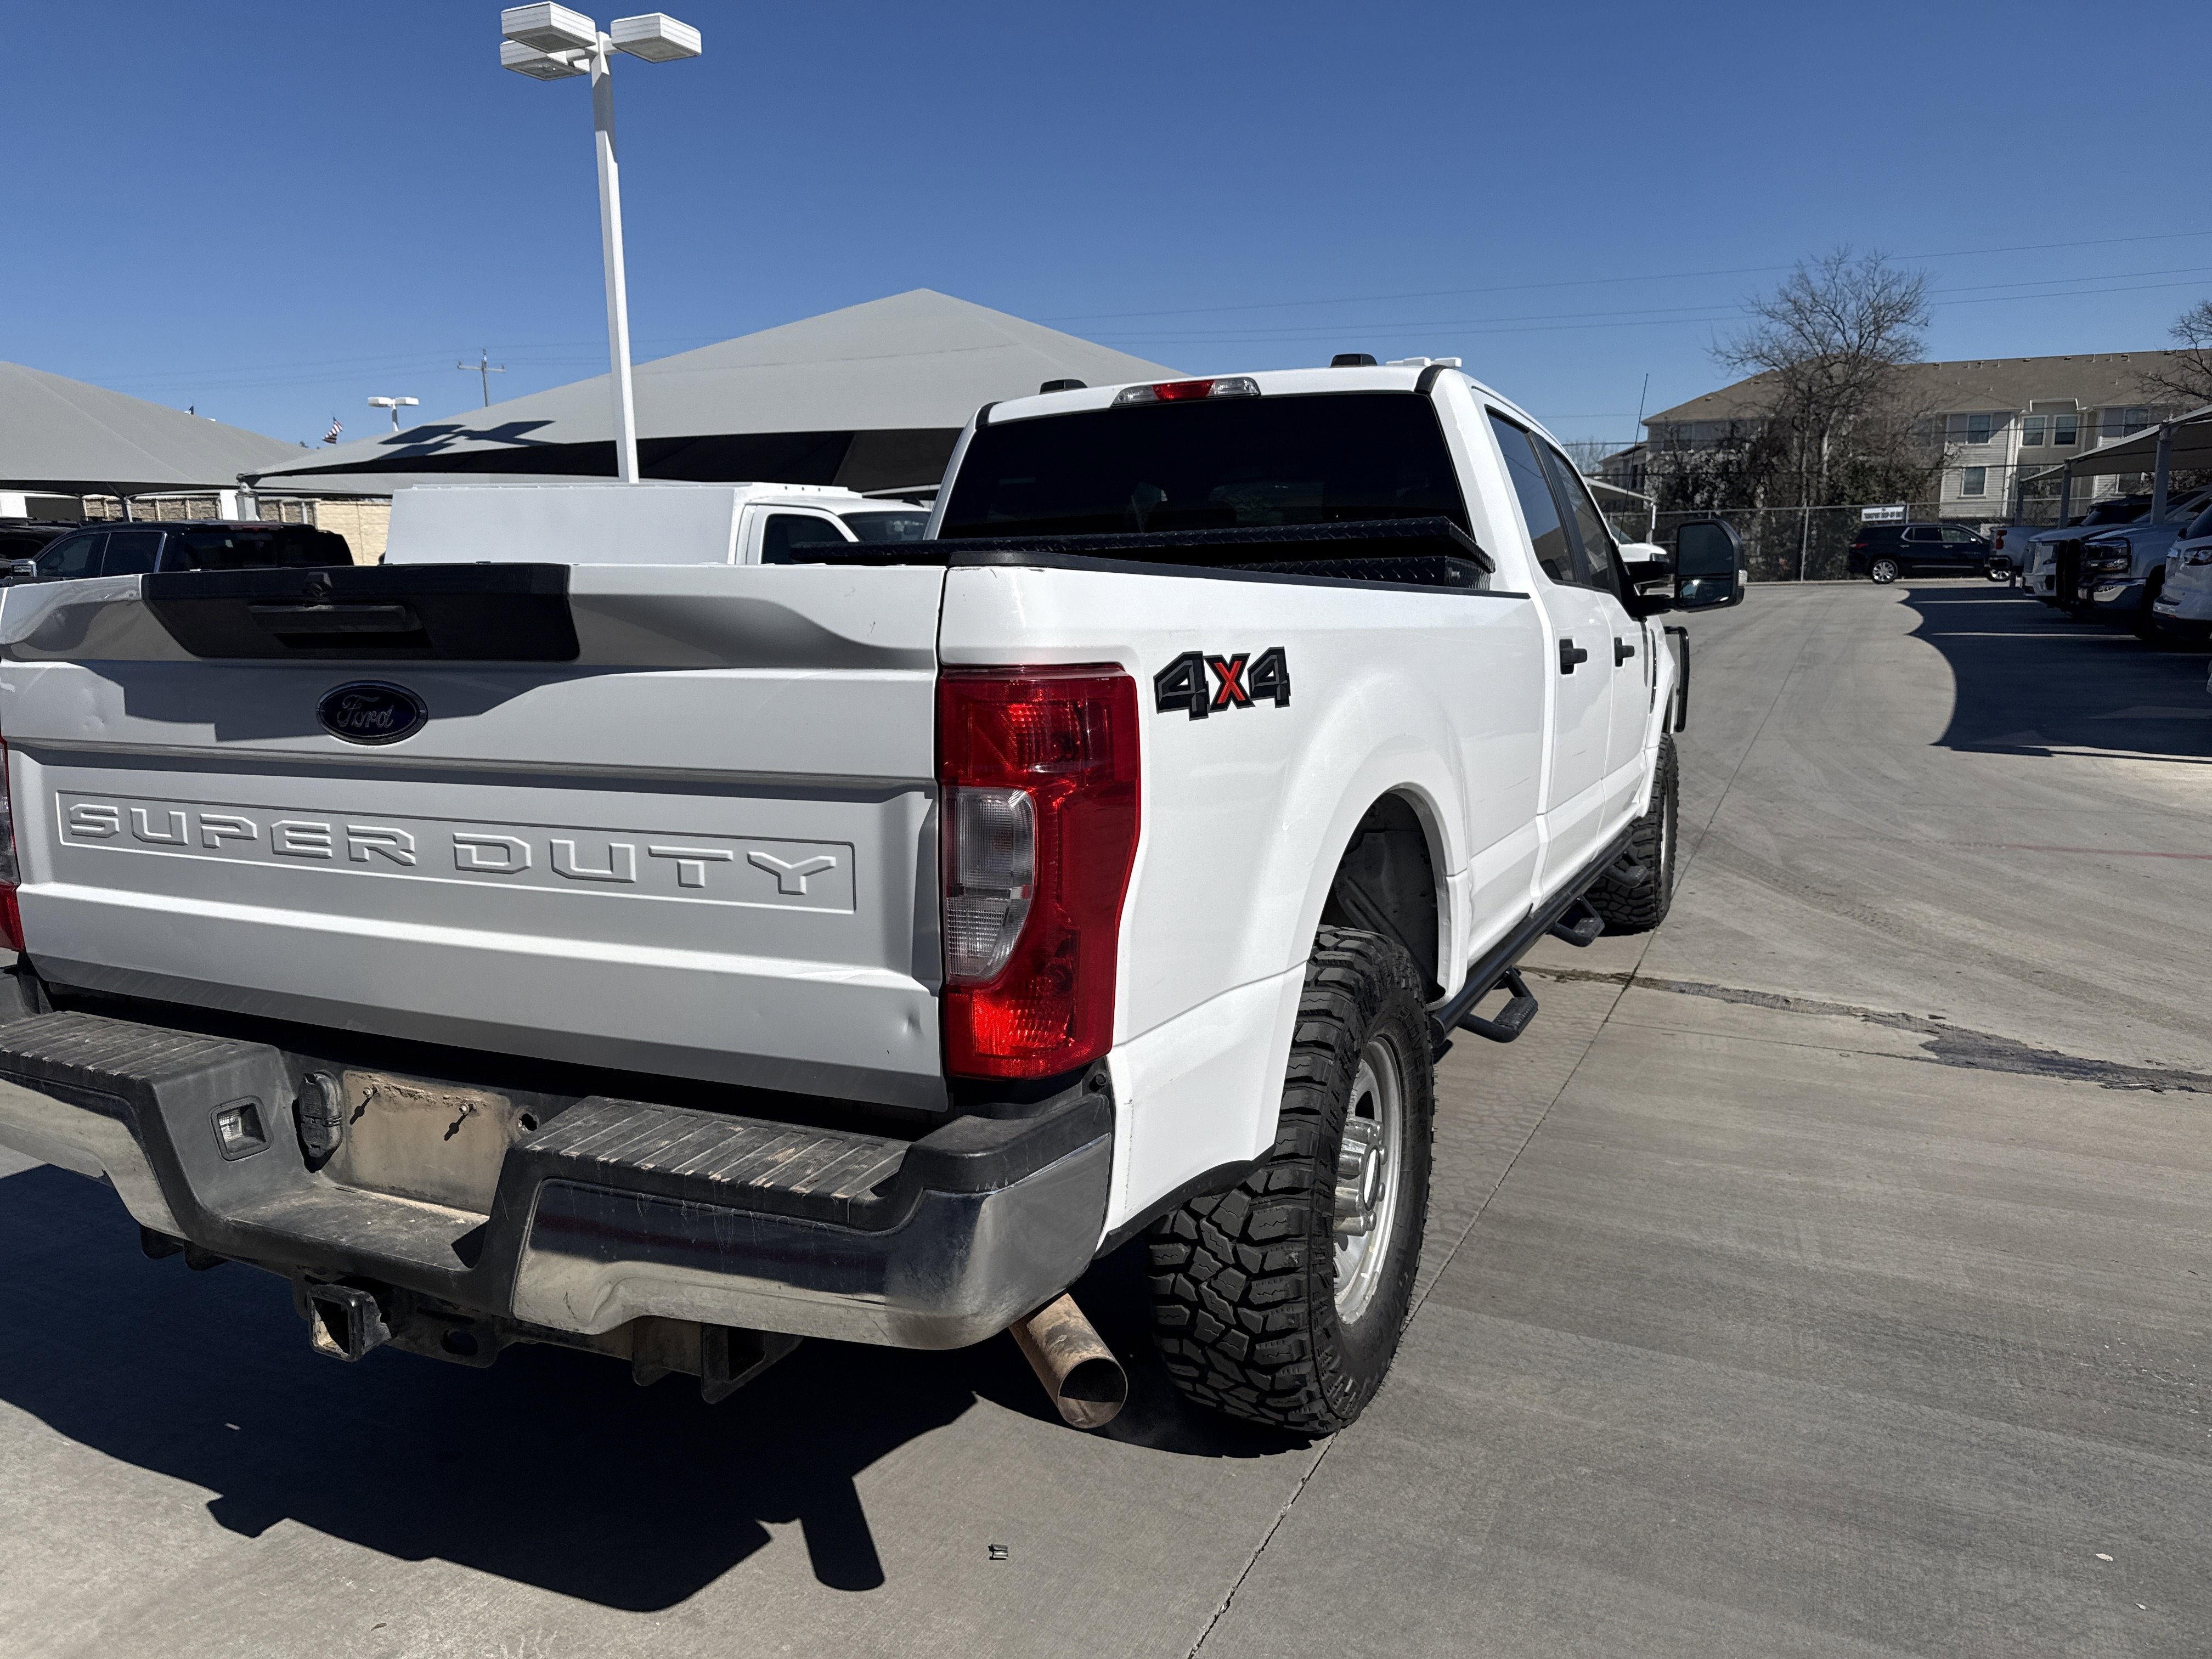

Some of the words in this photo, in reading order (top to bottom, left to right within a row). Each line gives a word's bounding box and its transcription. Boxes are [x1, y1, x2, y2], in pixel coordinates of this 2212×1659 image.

[336, 695, 394, 728] Ford
[69, 803, 416, 866] SUPER
[453, 832, 837, 895] DUTY
